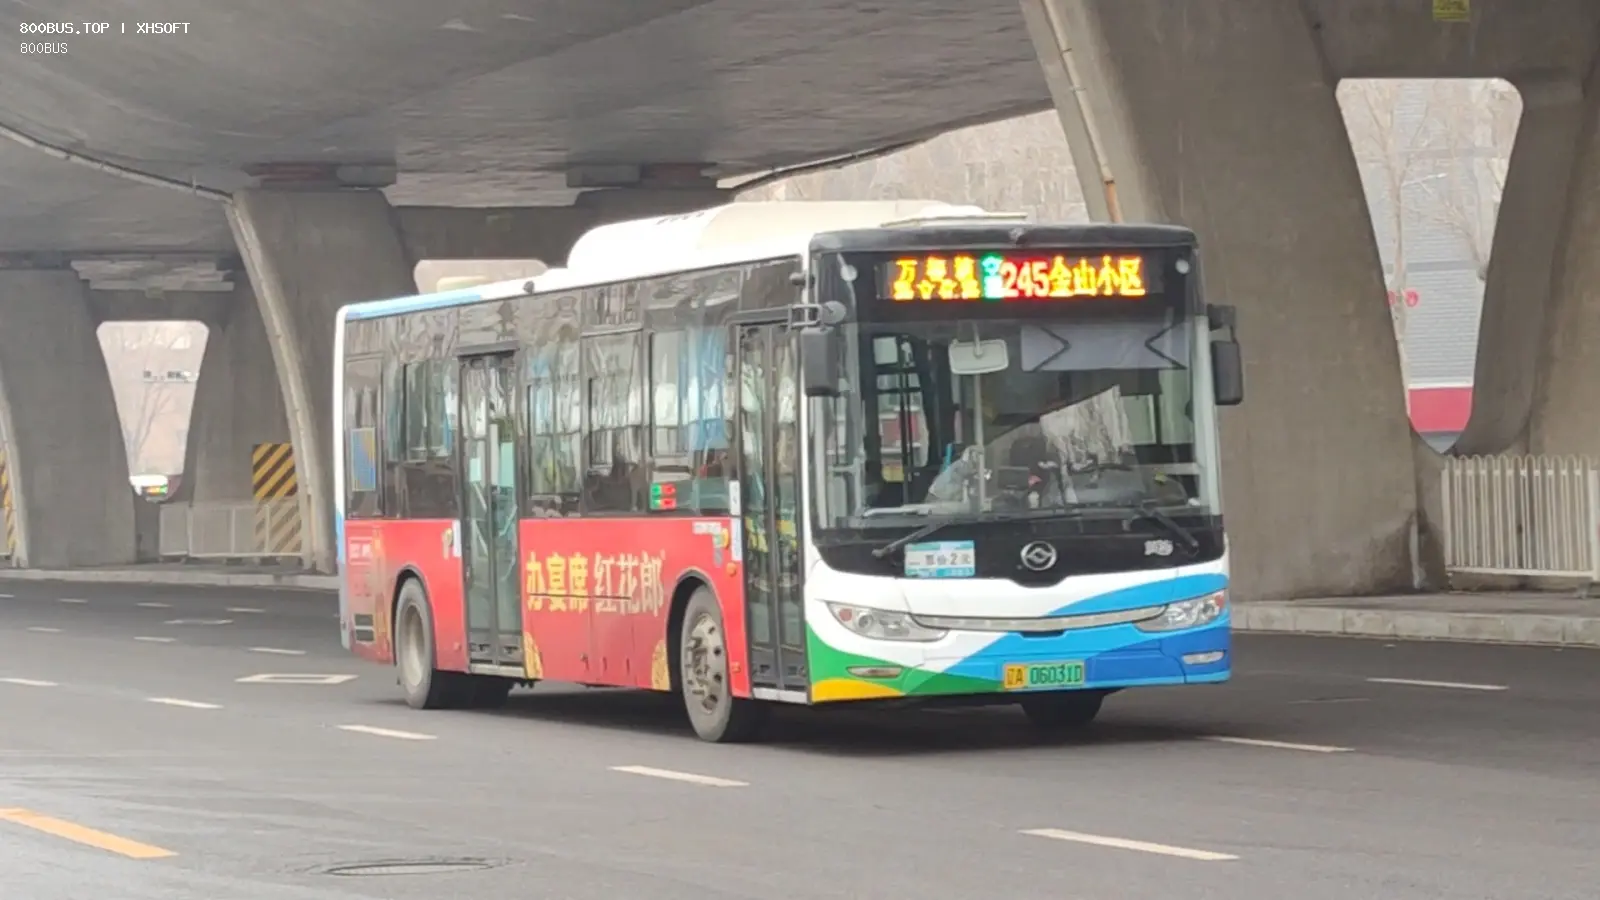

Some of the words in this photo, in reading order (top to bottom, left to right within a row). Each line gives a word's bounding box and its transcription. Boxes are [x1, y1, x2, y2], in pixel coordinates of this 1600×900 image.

[1000, 261, 1048, 297] 245
[1048, 255, 1145, 296] 金山小区
[526, 551, 589, 613] 办宴席
[594, 551, 664, 616] 红花郎
[1030, 664, 1083, 685] 06031D
